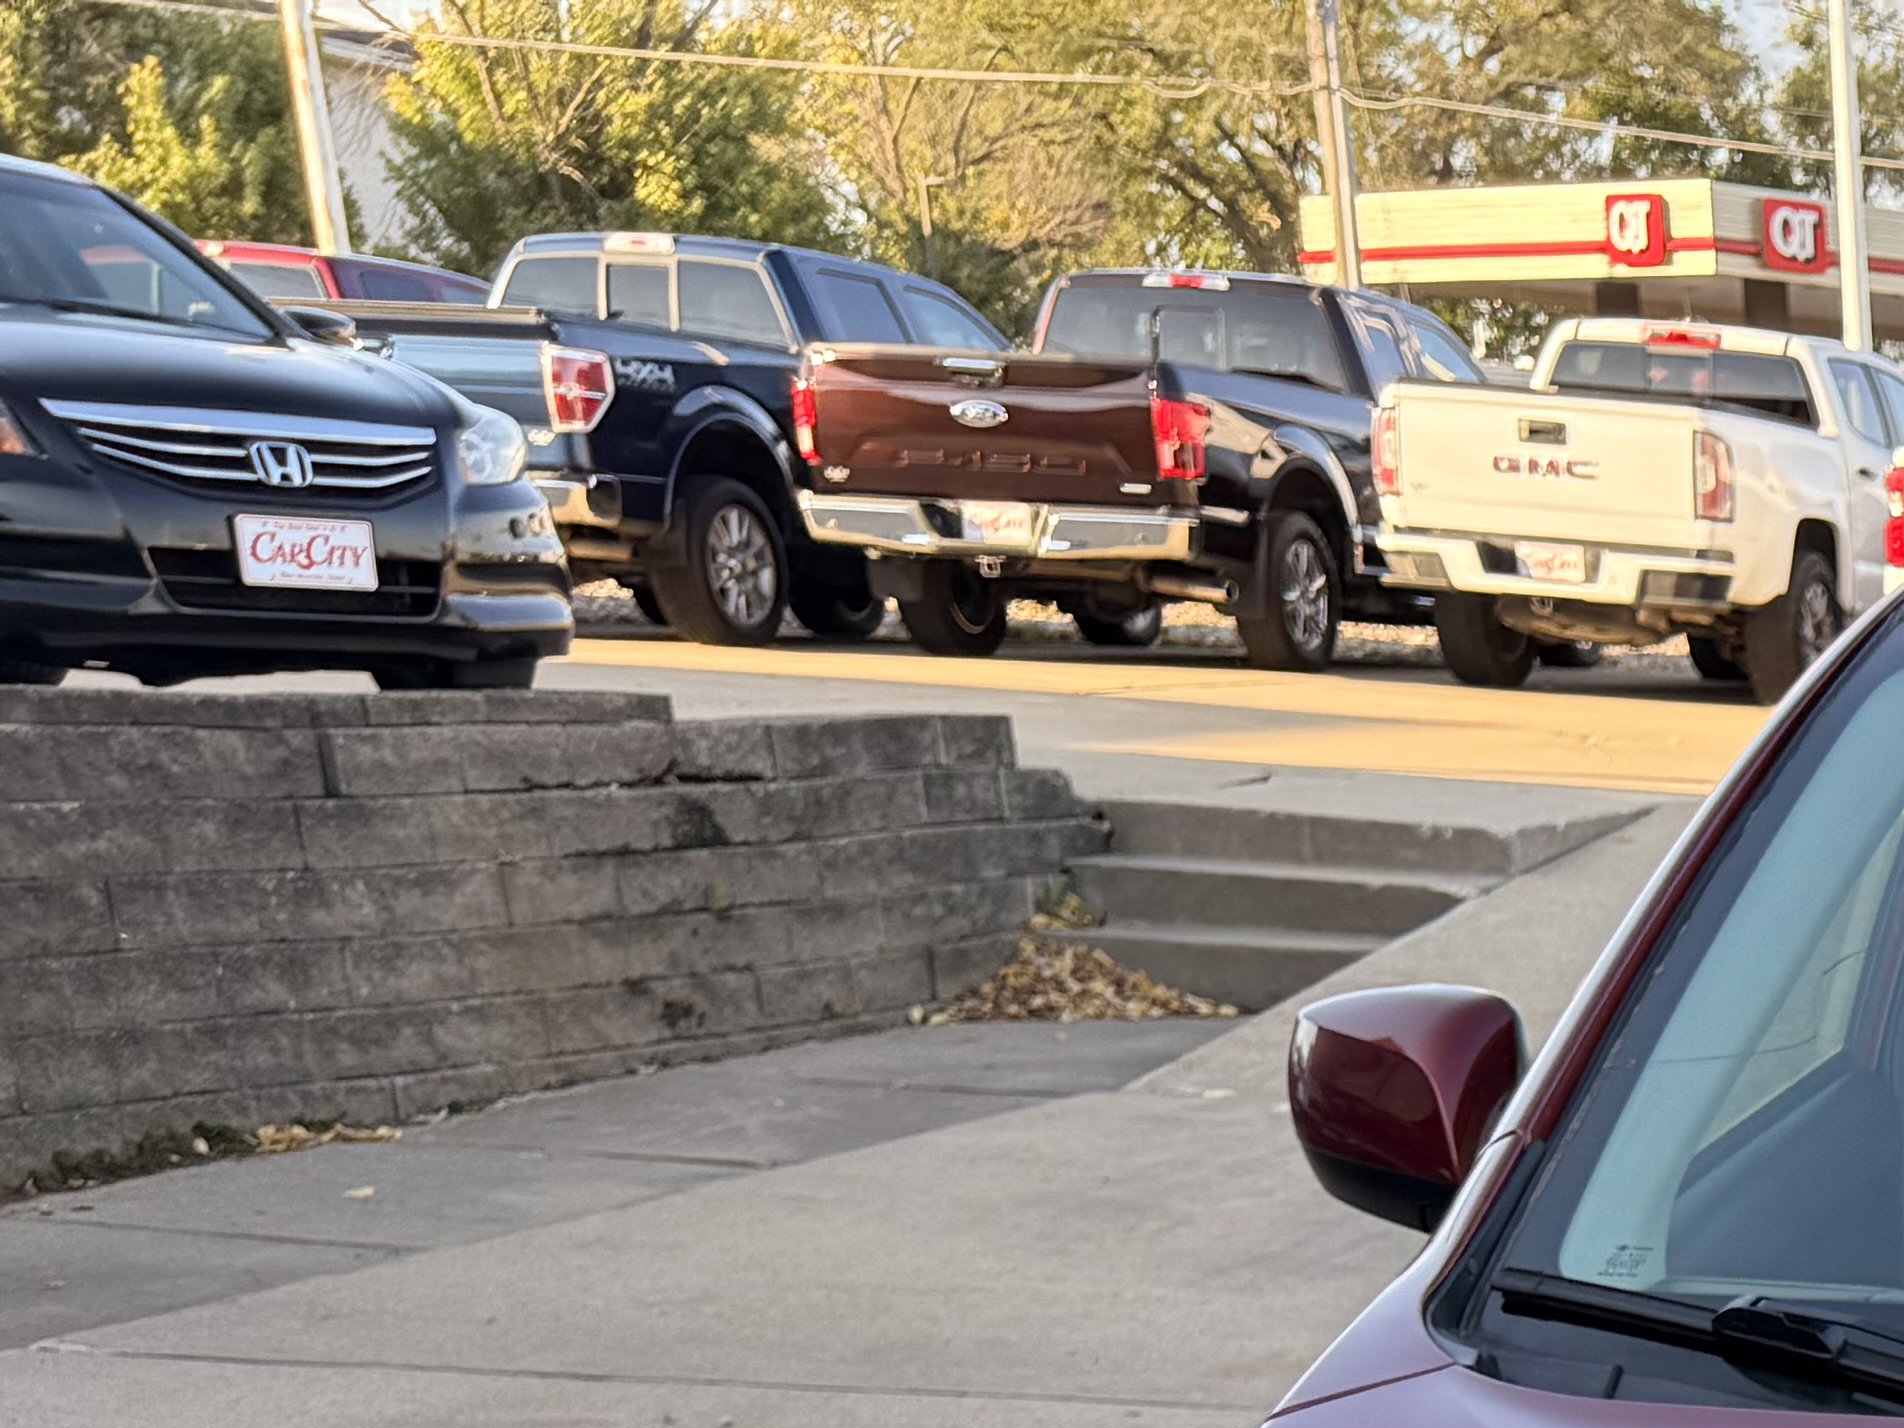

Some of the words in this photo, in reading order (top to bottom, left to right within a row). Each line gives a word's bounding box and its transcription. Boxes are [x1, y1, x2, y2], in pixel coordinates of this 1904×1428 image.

[1608, 199, 1651, 255] QT
[1768, 205, 1820, 262] QT
[1492, 455, 1600, 480] GMC
